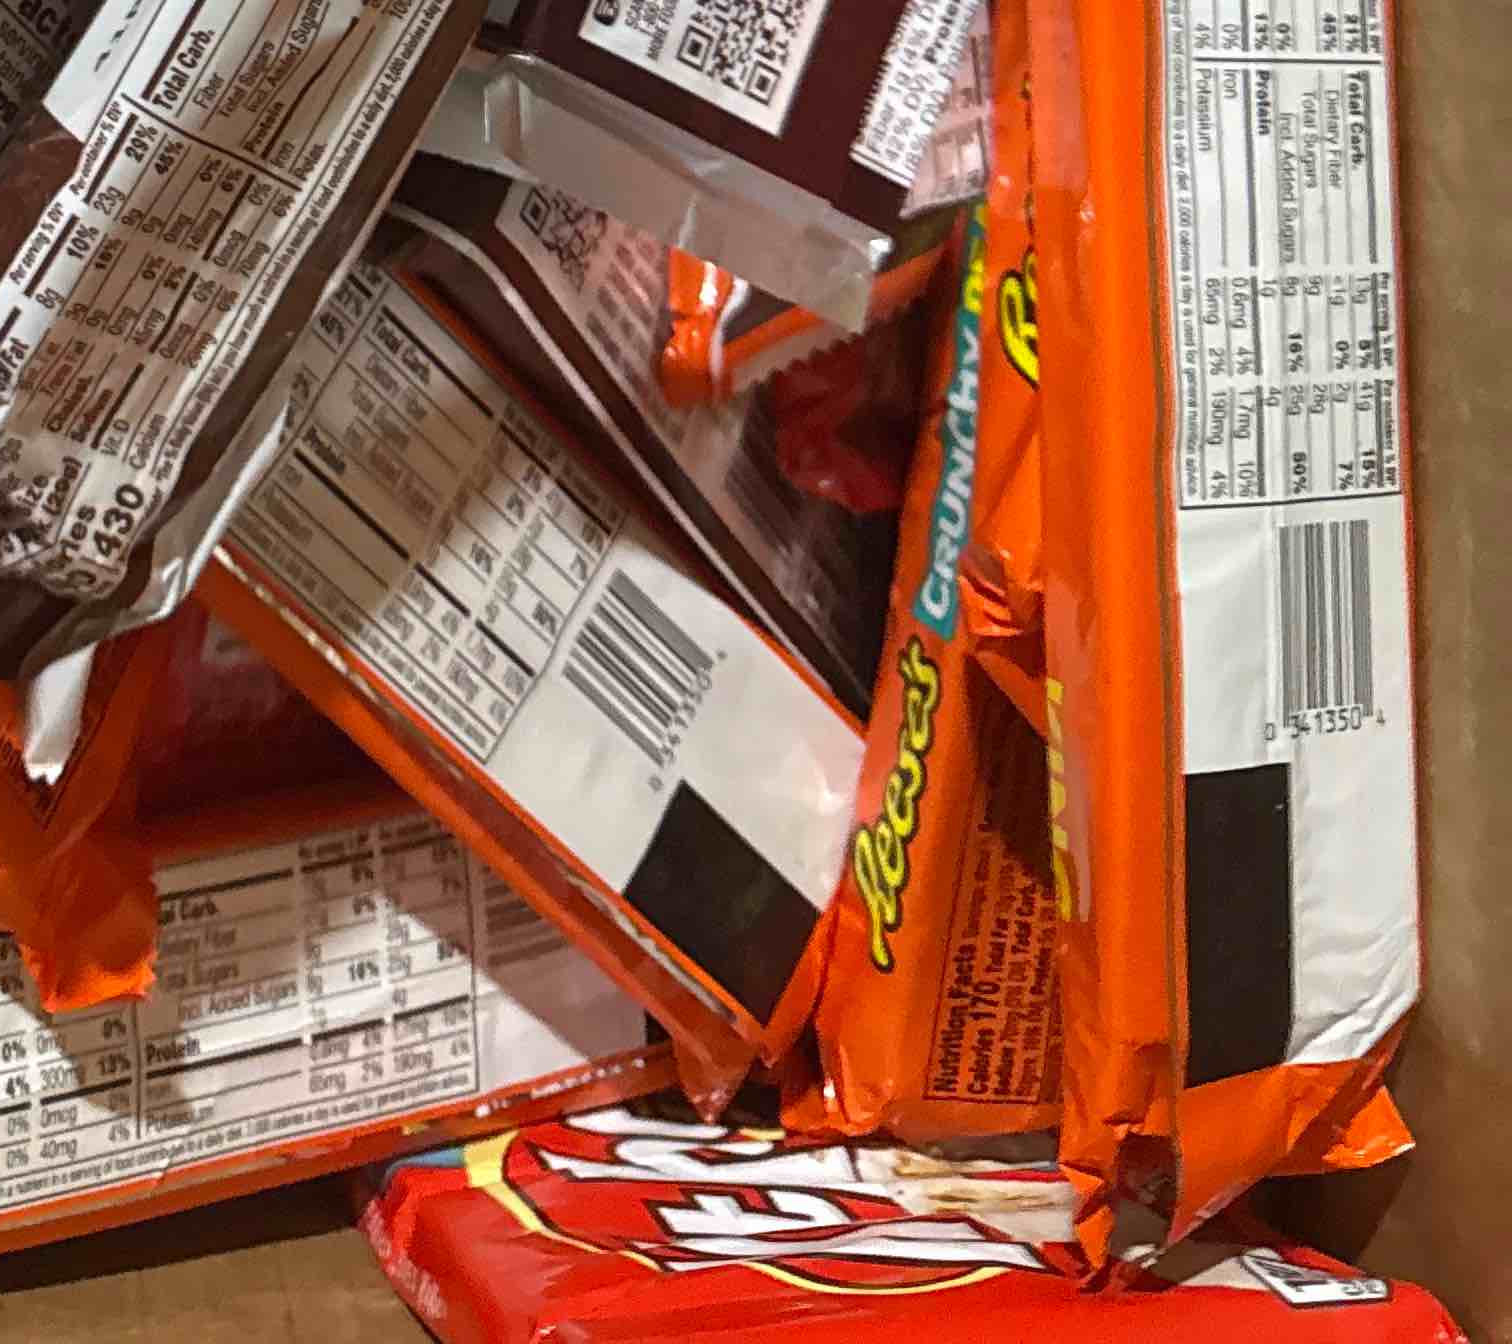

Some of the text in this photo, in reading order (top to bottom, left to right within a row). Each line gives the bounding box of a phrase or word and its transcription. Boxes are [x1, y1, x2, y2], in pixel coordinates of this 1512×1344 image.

[63, 220, 100, 263] 10%
[89, 180, 125, 218] 23g
[121, 119, 159, 163] 29%
[150, 62, 192, 112] Total
[174, 20, 216, 70] Carb.
[1252, 68, 1273, 137] Protein
[1297, 91, 1321, 189] Total Sugars
[1344, 71, 1363, 119] Total
[1276, 149, 1300, 264] Added Sugars
[1191, 67, 1230, 497] Potassium 2% 190mg 4%
[1220, 68, 1257, 496] Iron 4% 10%
[1319, 89, 1354, 490] Dietary Fiber 7%
[85, 478, 152, 562] 430
[920, 322, 983, 622] CRUNCHY
[1288, 706, 1362, 738] 341350
[853, 638, 944, 968] Reese's
[931, 942, 976, 1093] Nutrition Facts
[964, 978, 1001, 1094] Calories 170
[39, 1135, 80, 1164] 40mg
